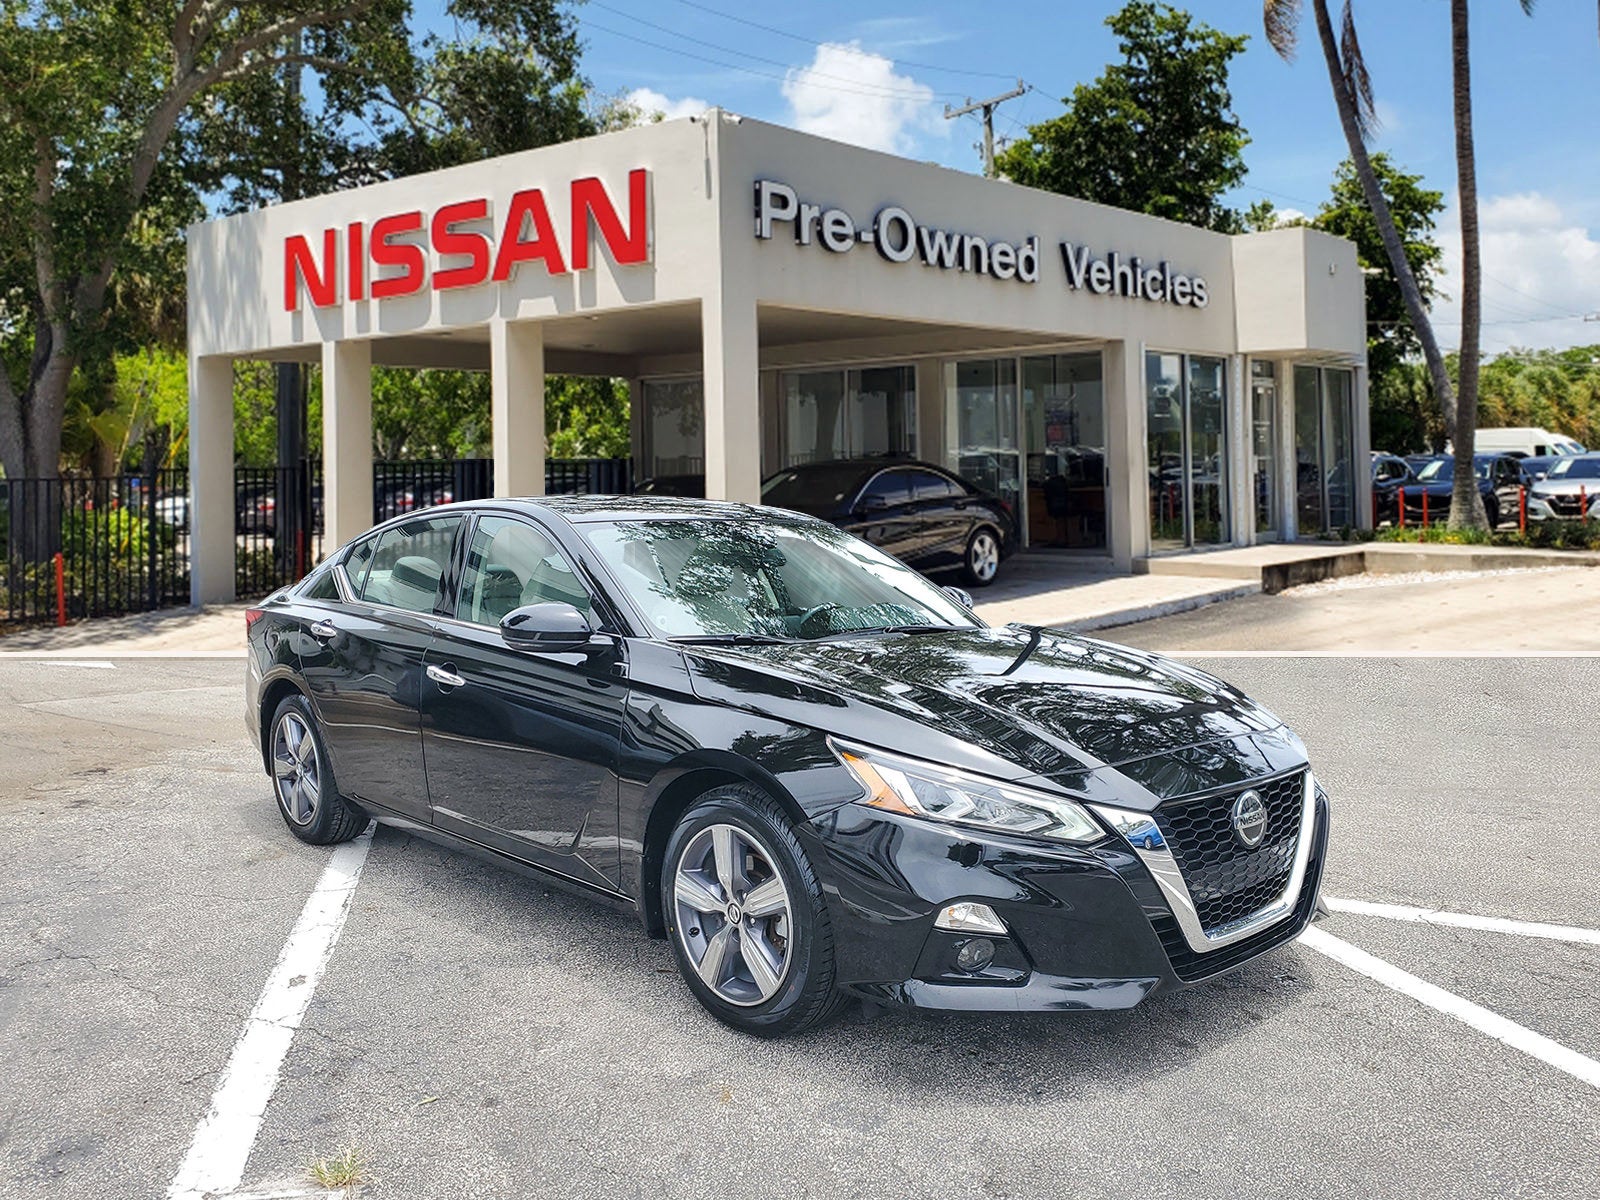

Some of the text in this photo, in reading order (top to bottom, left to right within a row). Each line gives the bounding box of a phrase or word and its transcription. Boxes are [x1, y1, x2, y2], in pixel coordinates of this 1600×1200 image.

[284, 168, 649, 311] NISSAN
[756, 179, 1208, 308] Pre-Owned Vehicles
[1240, 811, 1265, 826] NISSAN
